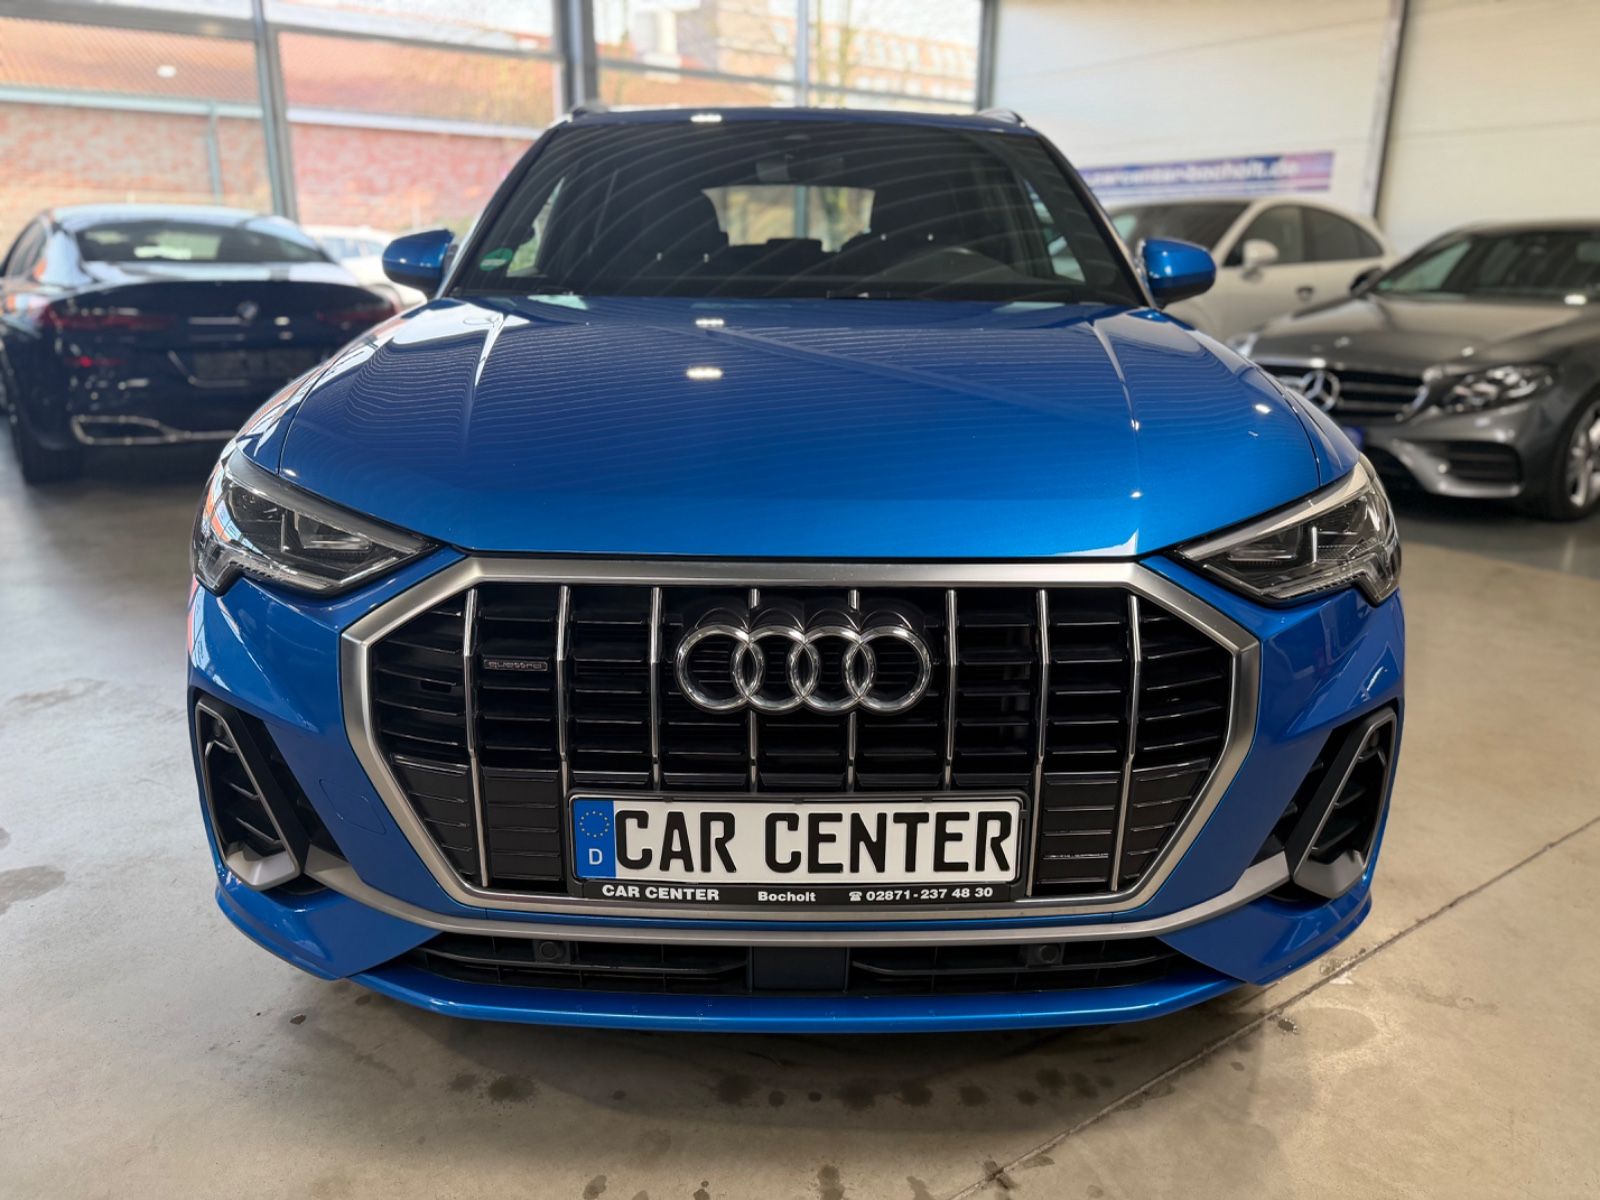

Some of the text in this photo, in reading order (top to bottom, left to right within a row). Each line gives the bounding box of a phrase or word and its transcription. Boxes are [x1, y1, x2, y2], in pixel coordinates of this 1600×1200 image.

[615, 810, 1012, 873] CAR CENTER
[588, 849, 603, 865] D
[602, 885, 720, 901] CAR CENTER
[758, 891, 817, 902] Bocholt
[952, 887, 970, 899] 48
[975, 887, 993, 898] 30
